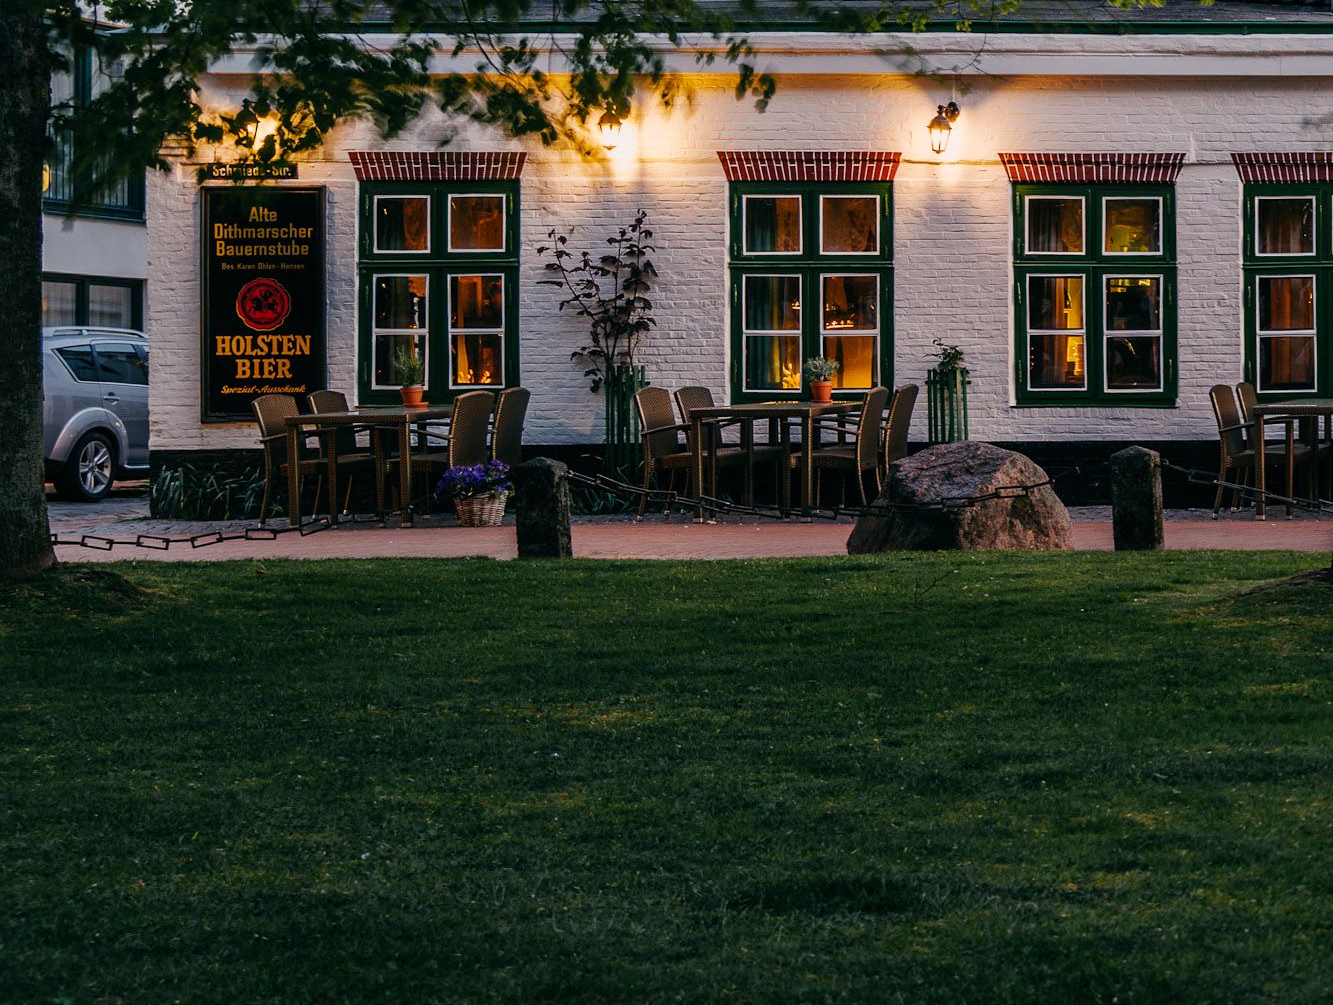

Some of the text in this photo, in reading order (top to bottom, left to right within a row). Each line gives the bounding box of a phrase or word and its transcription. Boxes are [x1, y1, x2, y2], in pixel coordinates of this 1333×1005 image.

[249, 206, 277, 222] Alte
[214, 223, 313, 239] Dithmarscher
[216, 241, 309, 257] Bauernstube
[215, 335, 311, 356] HOLSTEN
[235, 359, 293, 379] BIER
[220, 384, 306, 394] Spezial-Ausschank
